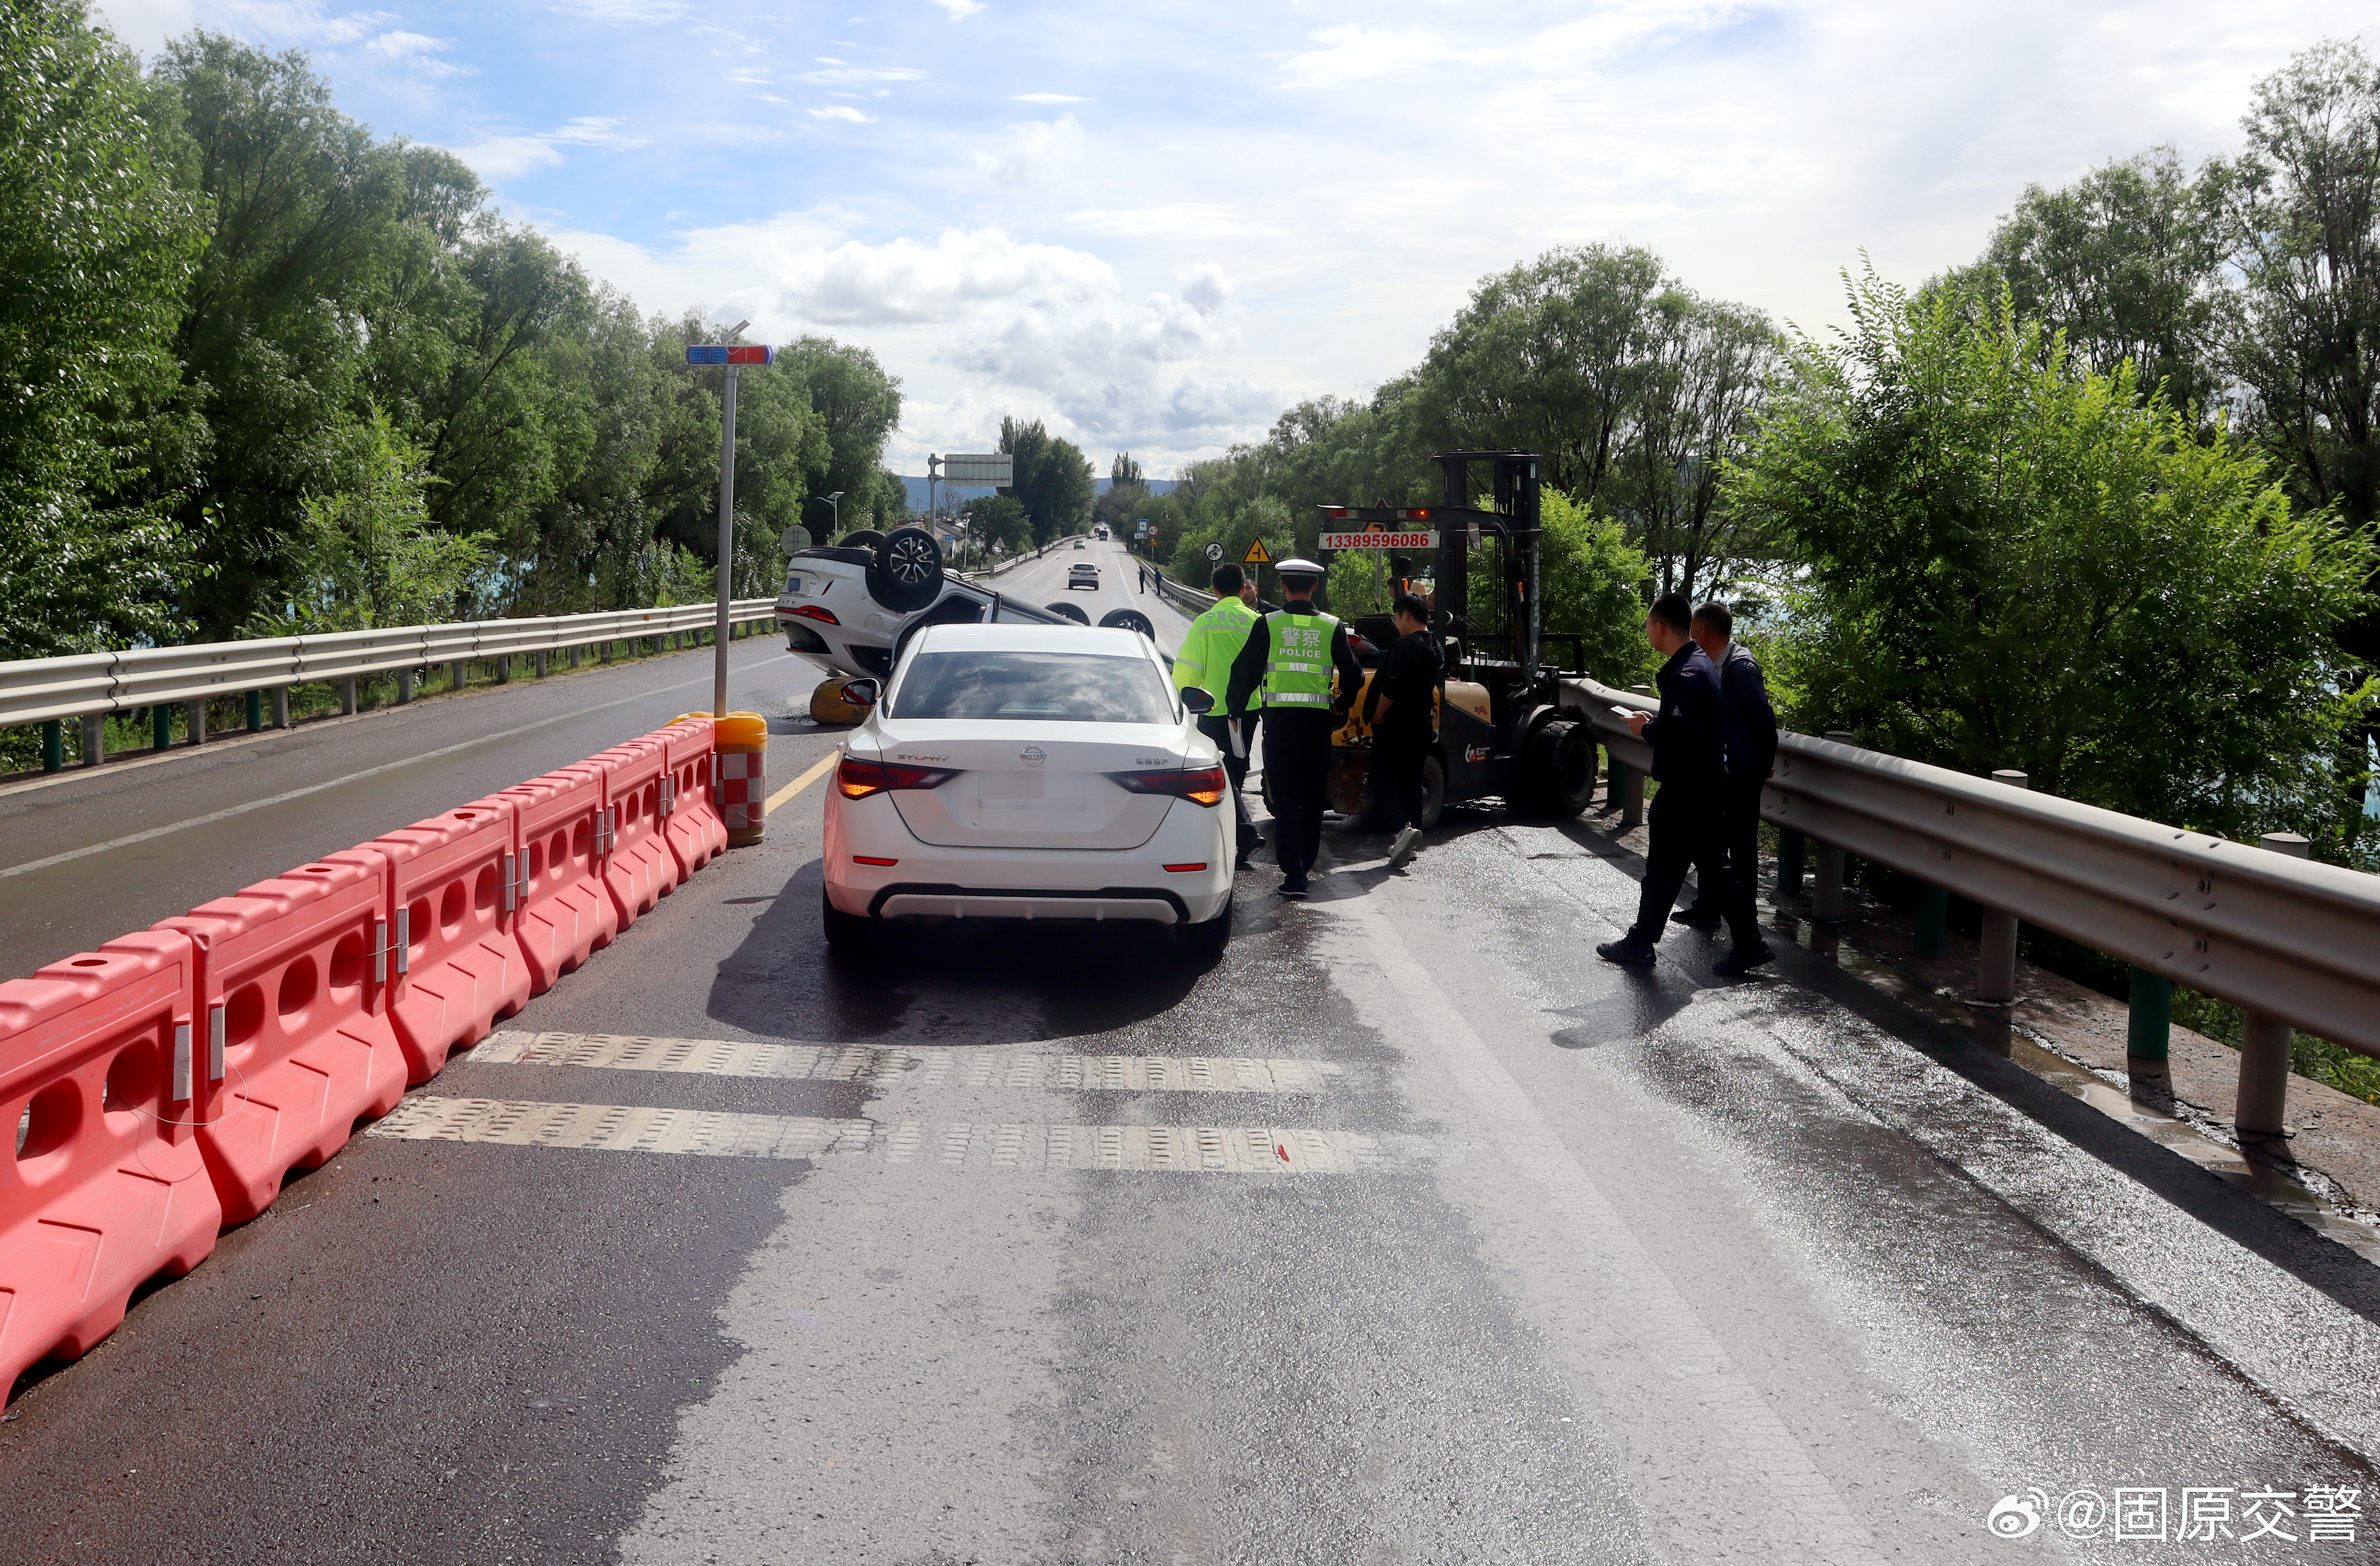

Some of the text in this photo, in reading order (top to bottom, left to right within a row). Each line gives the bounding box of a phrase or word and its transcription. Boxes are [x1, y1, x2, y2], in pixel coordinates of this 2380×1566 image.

[1326, 533, 1429, 548] 13389596086
[1205, 610, 1249, 626] 宁夏交警
[1281, 626, 1321, 647] 警察
[1279, 647, 1321, 658] POLICE
[898, 753, 949, 762] SYLPHY
